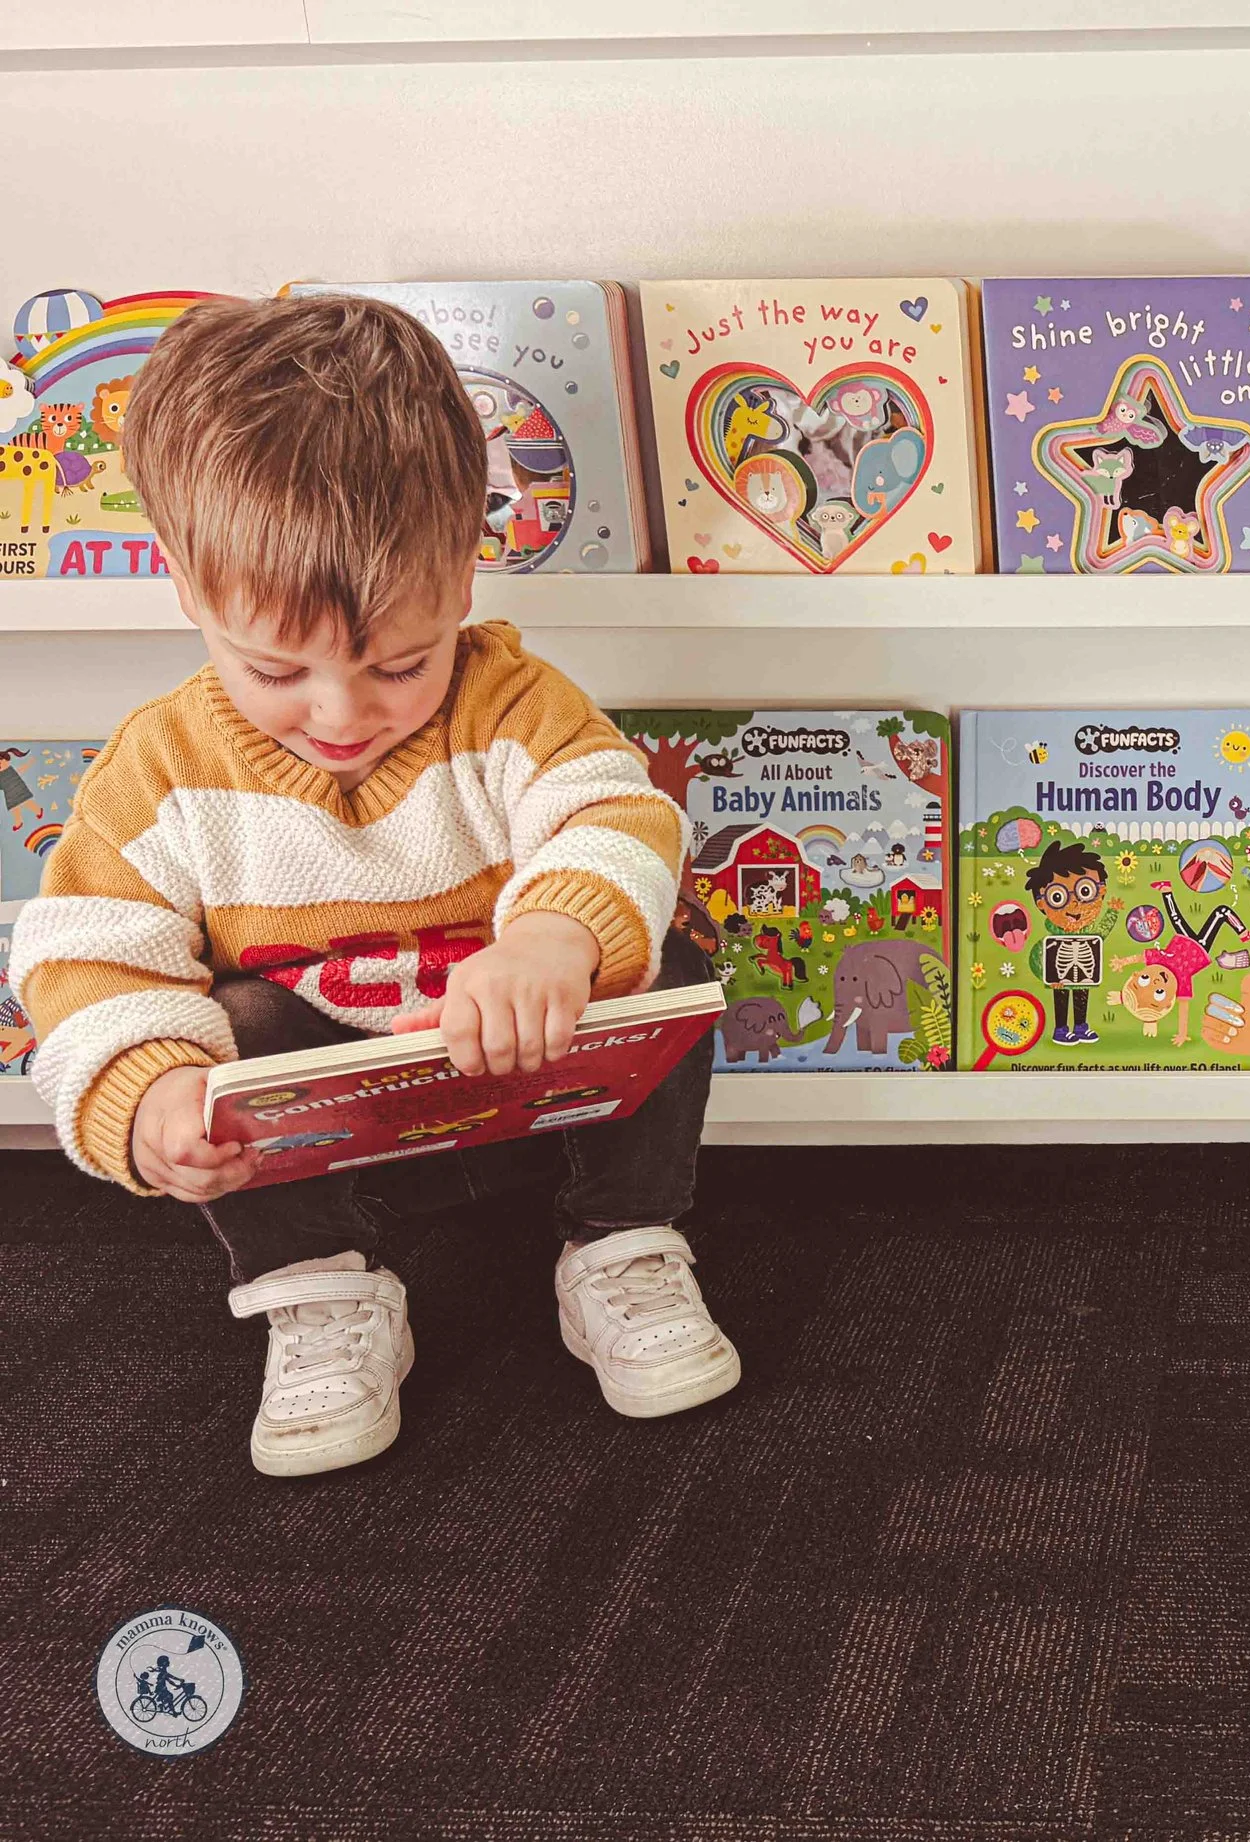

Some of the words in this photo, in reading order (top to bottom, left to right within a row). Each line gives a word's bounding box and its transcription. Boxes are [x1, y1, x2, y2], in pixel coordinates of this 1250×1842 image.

[687, 304, 744, 355] Just
[758, 299, 806, 326] the
[820, 304, 880, 337] way
[1011, 322, 1094, 351] Shine
[1106, 304, 1206, 348] bright
[513, 344, 564, 370] you
[803, 335, 854, 365] you
[868, 338, 918, 364] are
[60, 540, 113, 576] AT
[768, 733, 846, 750] FUNFACTS
[1101, 732, 1176, 748] FUNFACTS
[760, 764, 781, 781] All
[784, 764, 833, 781] About
[1079, 762, 1146, 779] Discover
[1149, 762, 1176, 779] the
[713, 785, 777, 818] Baby
[780, 784, 883, 813] Animals
[1036, 781, 1138, 813] Human
[1146, 780, 1222, 818] Body
[361, 1067, 434, 1087] Let's
[1011, 1063, 1055, 1071] Discover
[254, 1070, 460, 1122] Constructi
